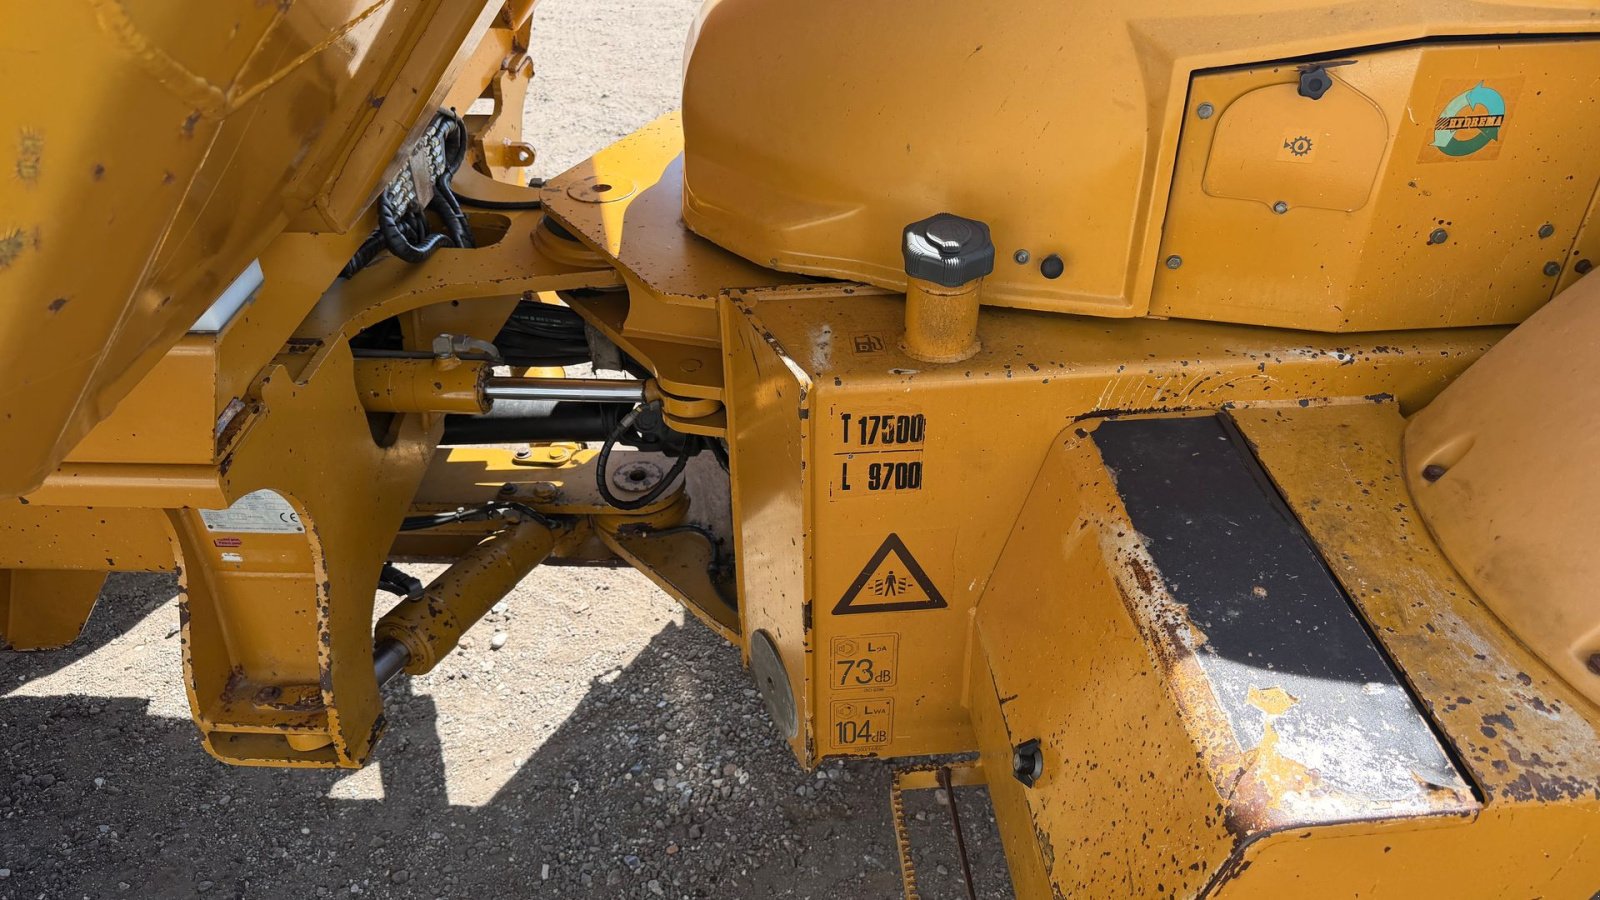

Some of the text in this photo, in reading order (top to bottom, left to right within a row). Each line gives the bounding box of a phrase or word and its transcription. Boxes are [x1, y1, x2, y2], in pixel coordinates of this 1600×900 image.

[1448, 115, 1502, 129] HYDREMA
[840, 412, 925, 445] T 17500
[842, 461, 922, 491] L 9700
[280, 512, 298, 523] CE
